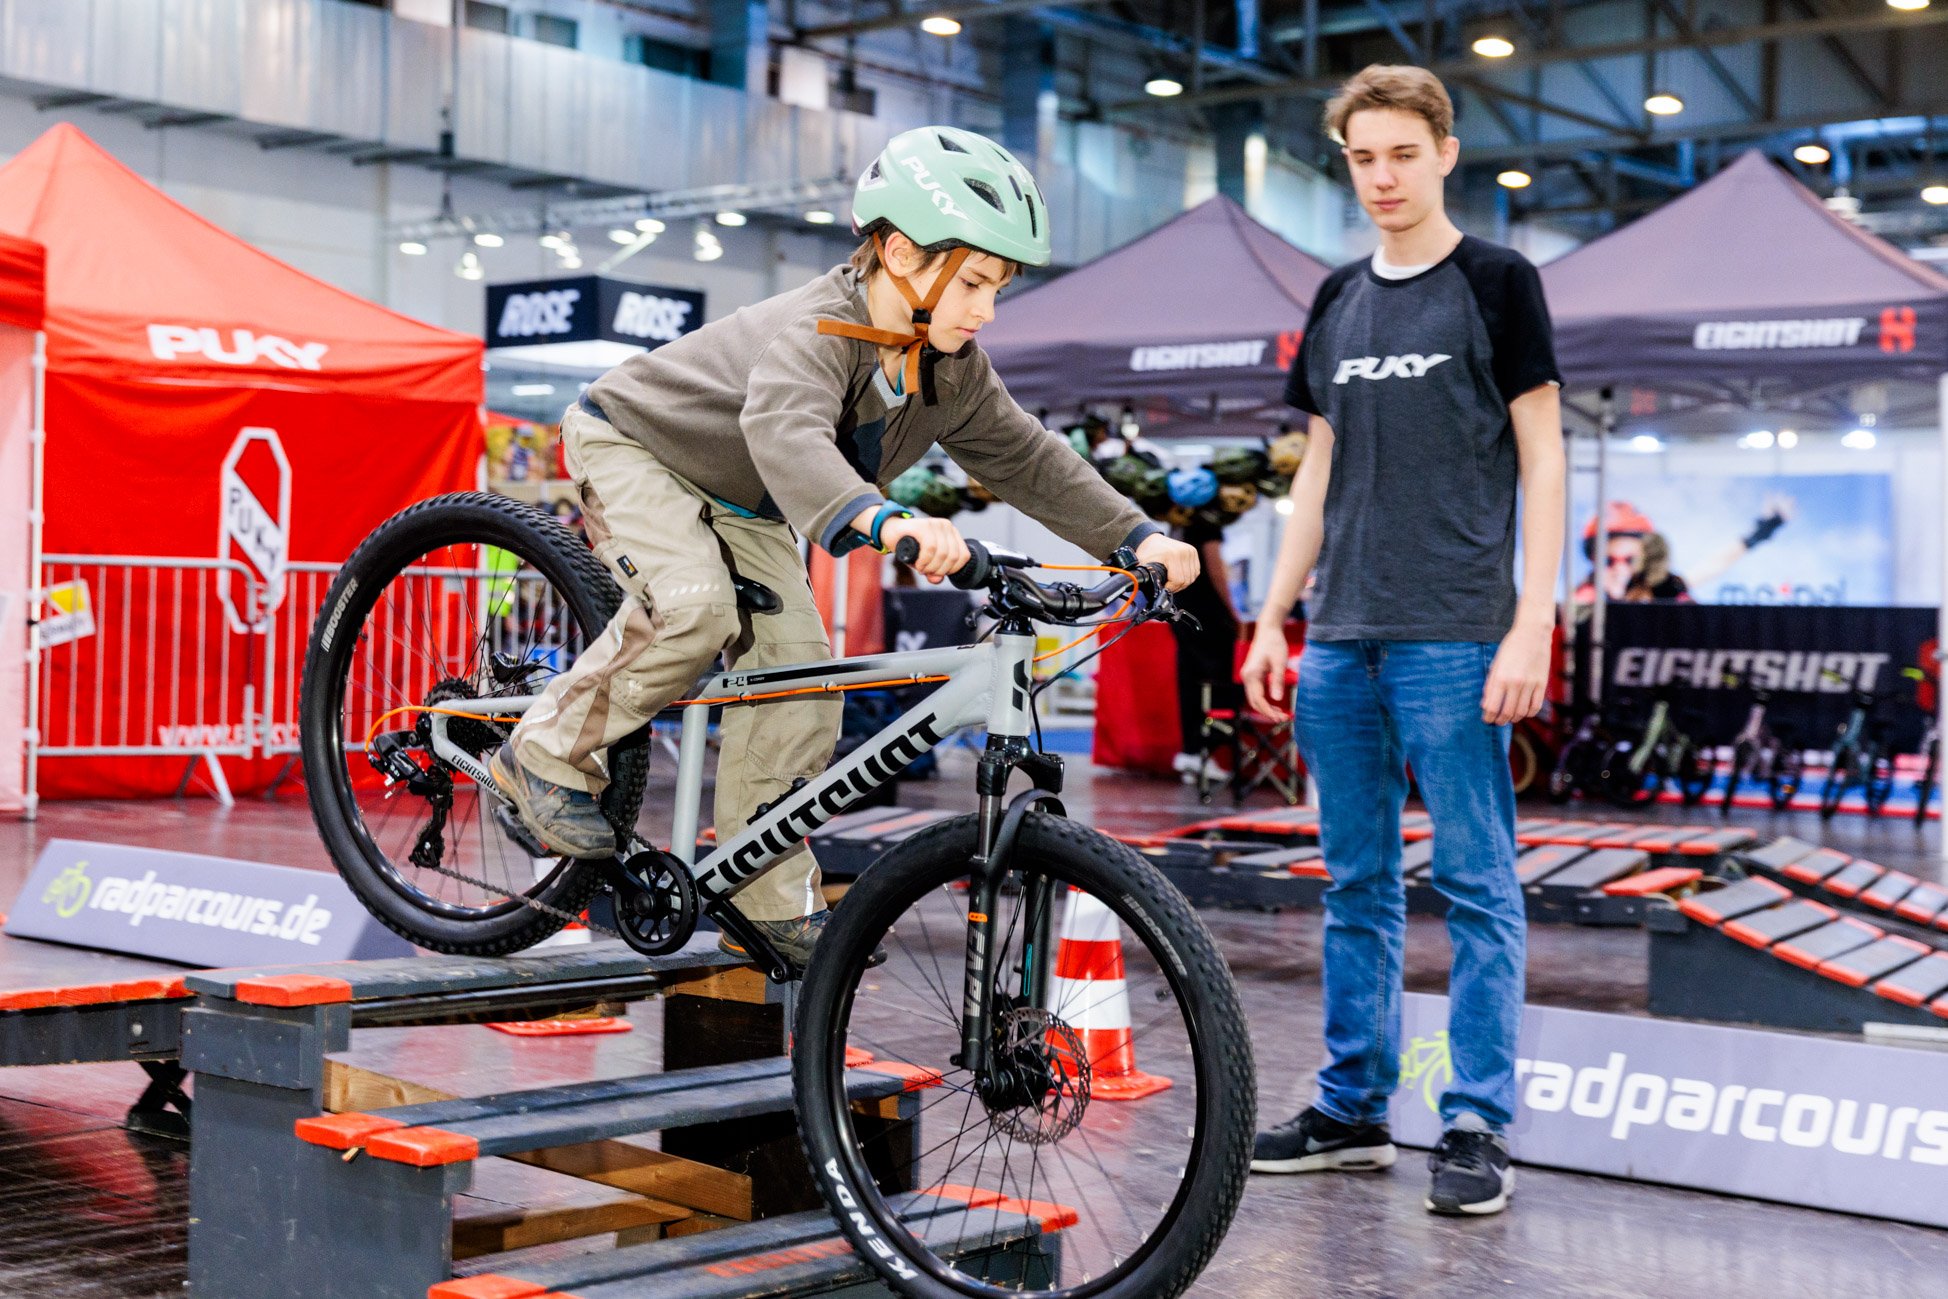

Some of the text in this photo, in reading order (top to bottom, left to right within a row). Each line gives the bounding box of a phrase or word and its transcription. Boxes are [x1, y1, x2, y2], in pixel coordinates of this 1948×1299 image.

[900, 156, 970, 221] PUKY
[498, 289, 581, 337] ROSE
[612, 290, 693, 341] ROSE
[1694, 317, 1868, 350] EIGHTSHOT
[146, 323, 330, 371] PUKY
[1332, 353, 1453, 384] PUKY
[229, 487, 280, 572] PUKY
[325, 577, 359, 639] BOOSTER
[89, 869, 333, 946] radparcours.de
[825, 1157, 919, 1280] KENDA
